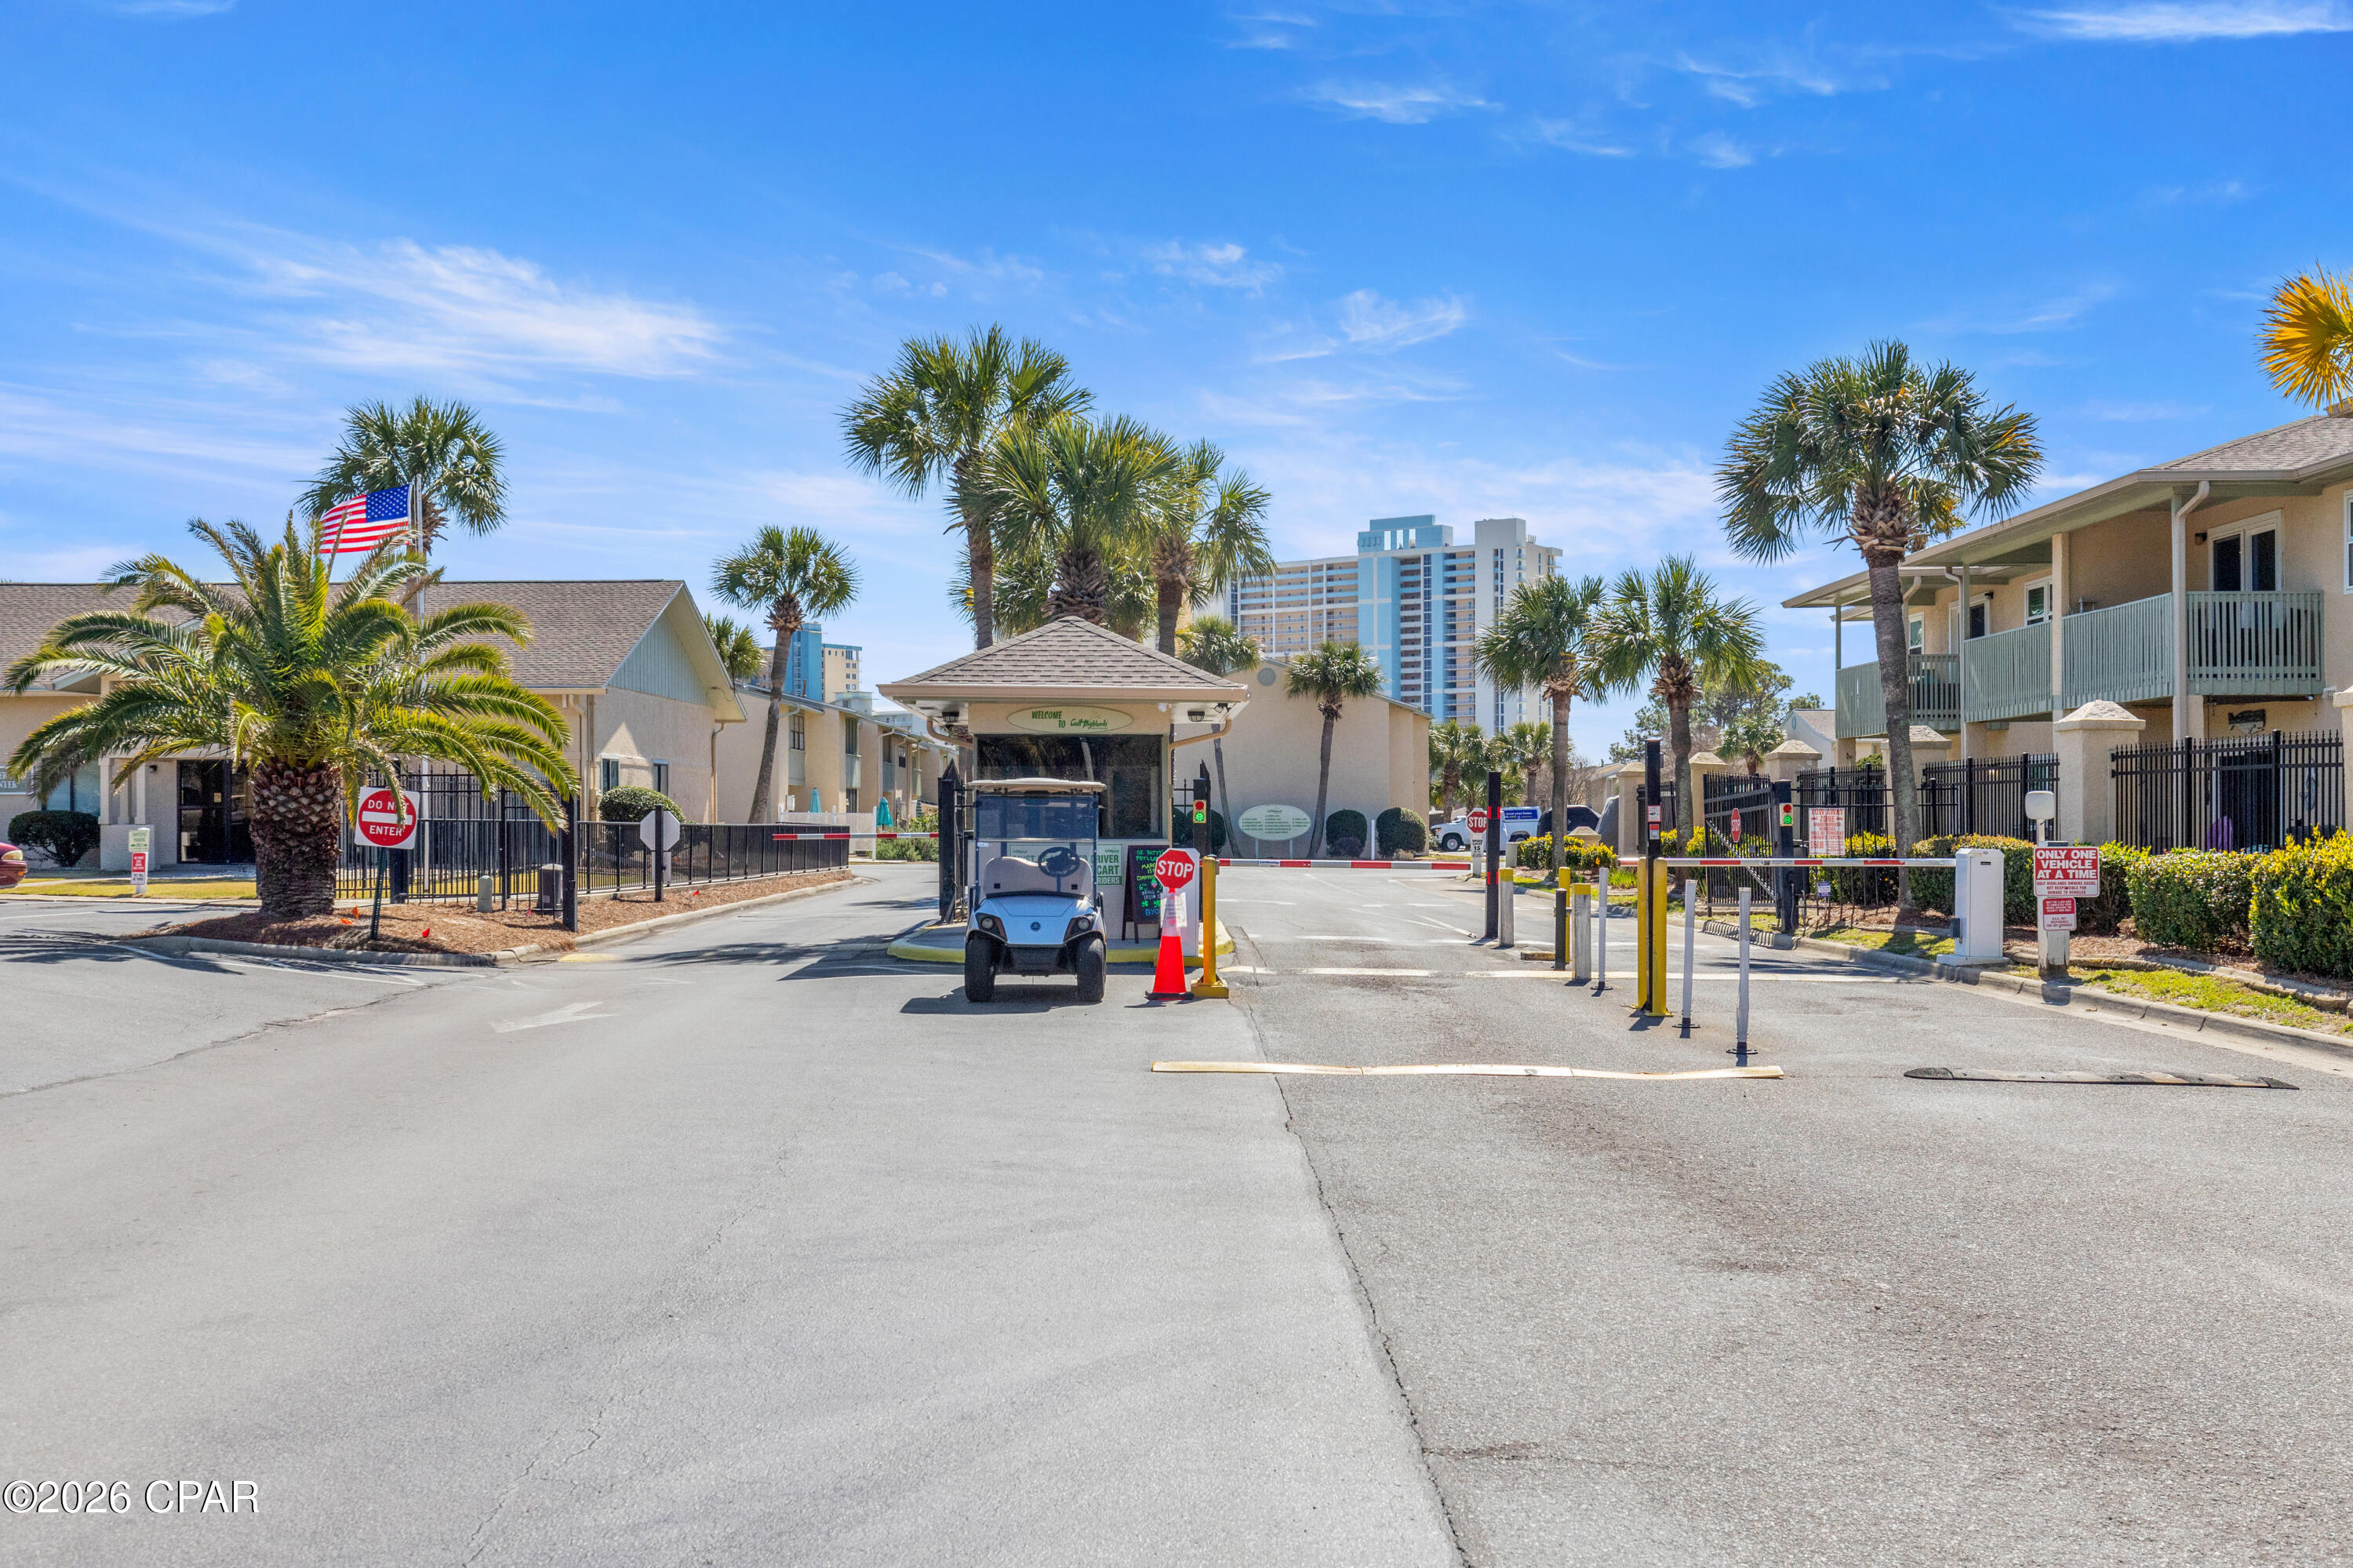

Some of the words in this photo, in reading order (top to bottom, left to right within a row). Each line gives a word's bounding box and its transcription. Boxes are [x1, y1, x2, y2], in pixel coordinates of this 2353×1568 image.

[1031, 711, 1062, 719] WELCOME
[368, 799, 383, 809] DO
[387, 801, 409, 813] NT
[1732, 819, 1740, 831] STOP
[369, 825, 402, 836] ENTER
[2036, 849, 2068, 859] ONLY
[2071, 849, 2097, 859] ONE
[1157, 860, 1193, 878] STOP
[2040, 860, 2093, 869] VEHICLE
[1097, 865, 1119, 875] CART
[2037, 869, 2052, 879] AT
[2055, 869, 2064, 879] A
[2067, 869, 2097, 879] TIME
